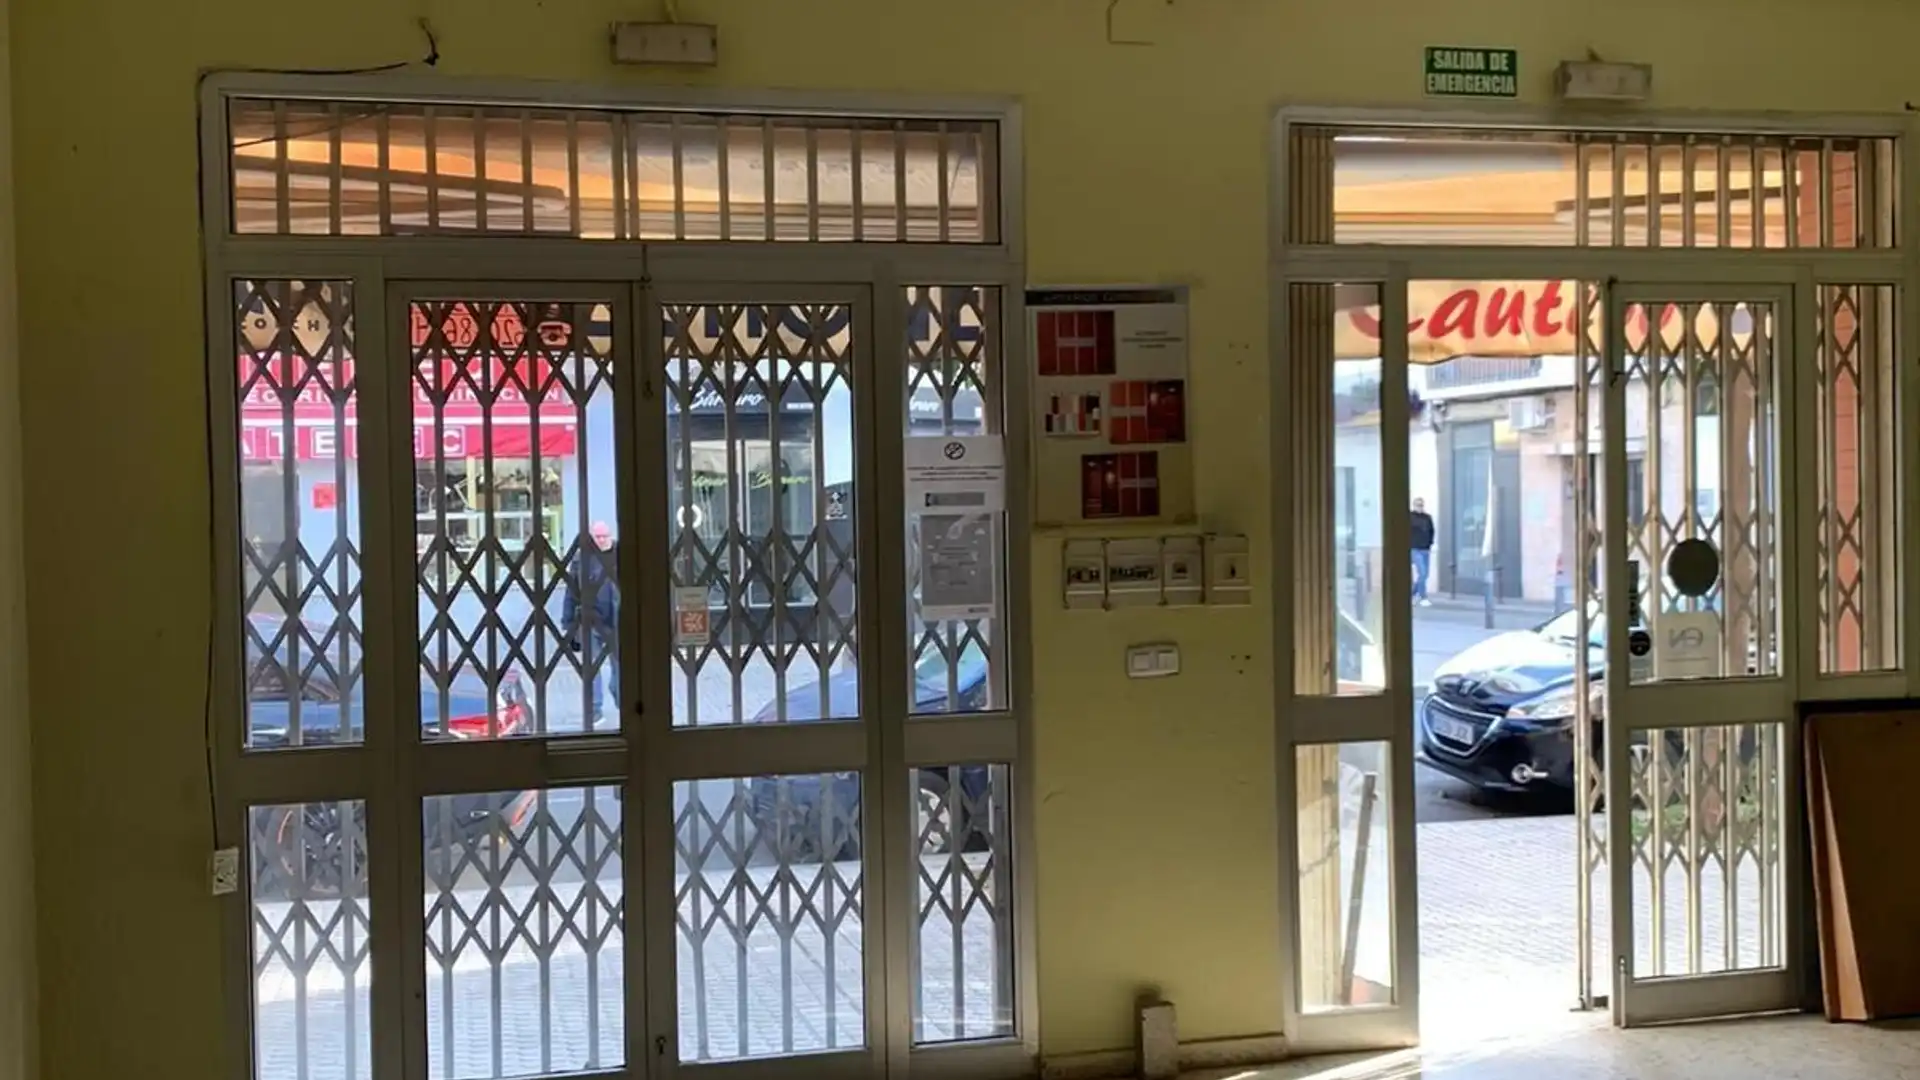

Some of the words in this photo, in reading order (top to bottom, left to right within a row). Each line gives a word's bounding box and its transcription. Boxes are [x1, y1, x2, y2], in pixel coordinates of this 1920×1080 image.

[1433, 50, 1485, 70] SALIDA
[1489, 52, 1509, 71] DE
[1427, 73, 1515, 93] EMERGENCIA
